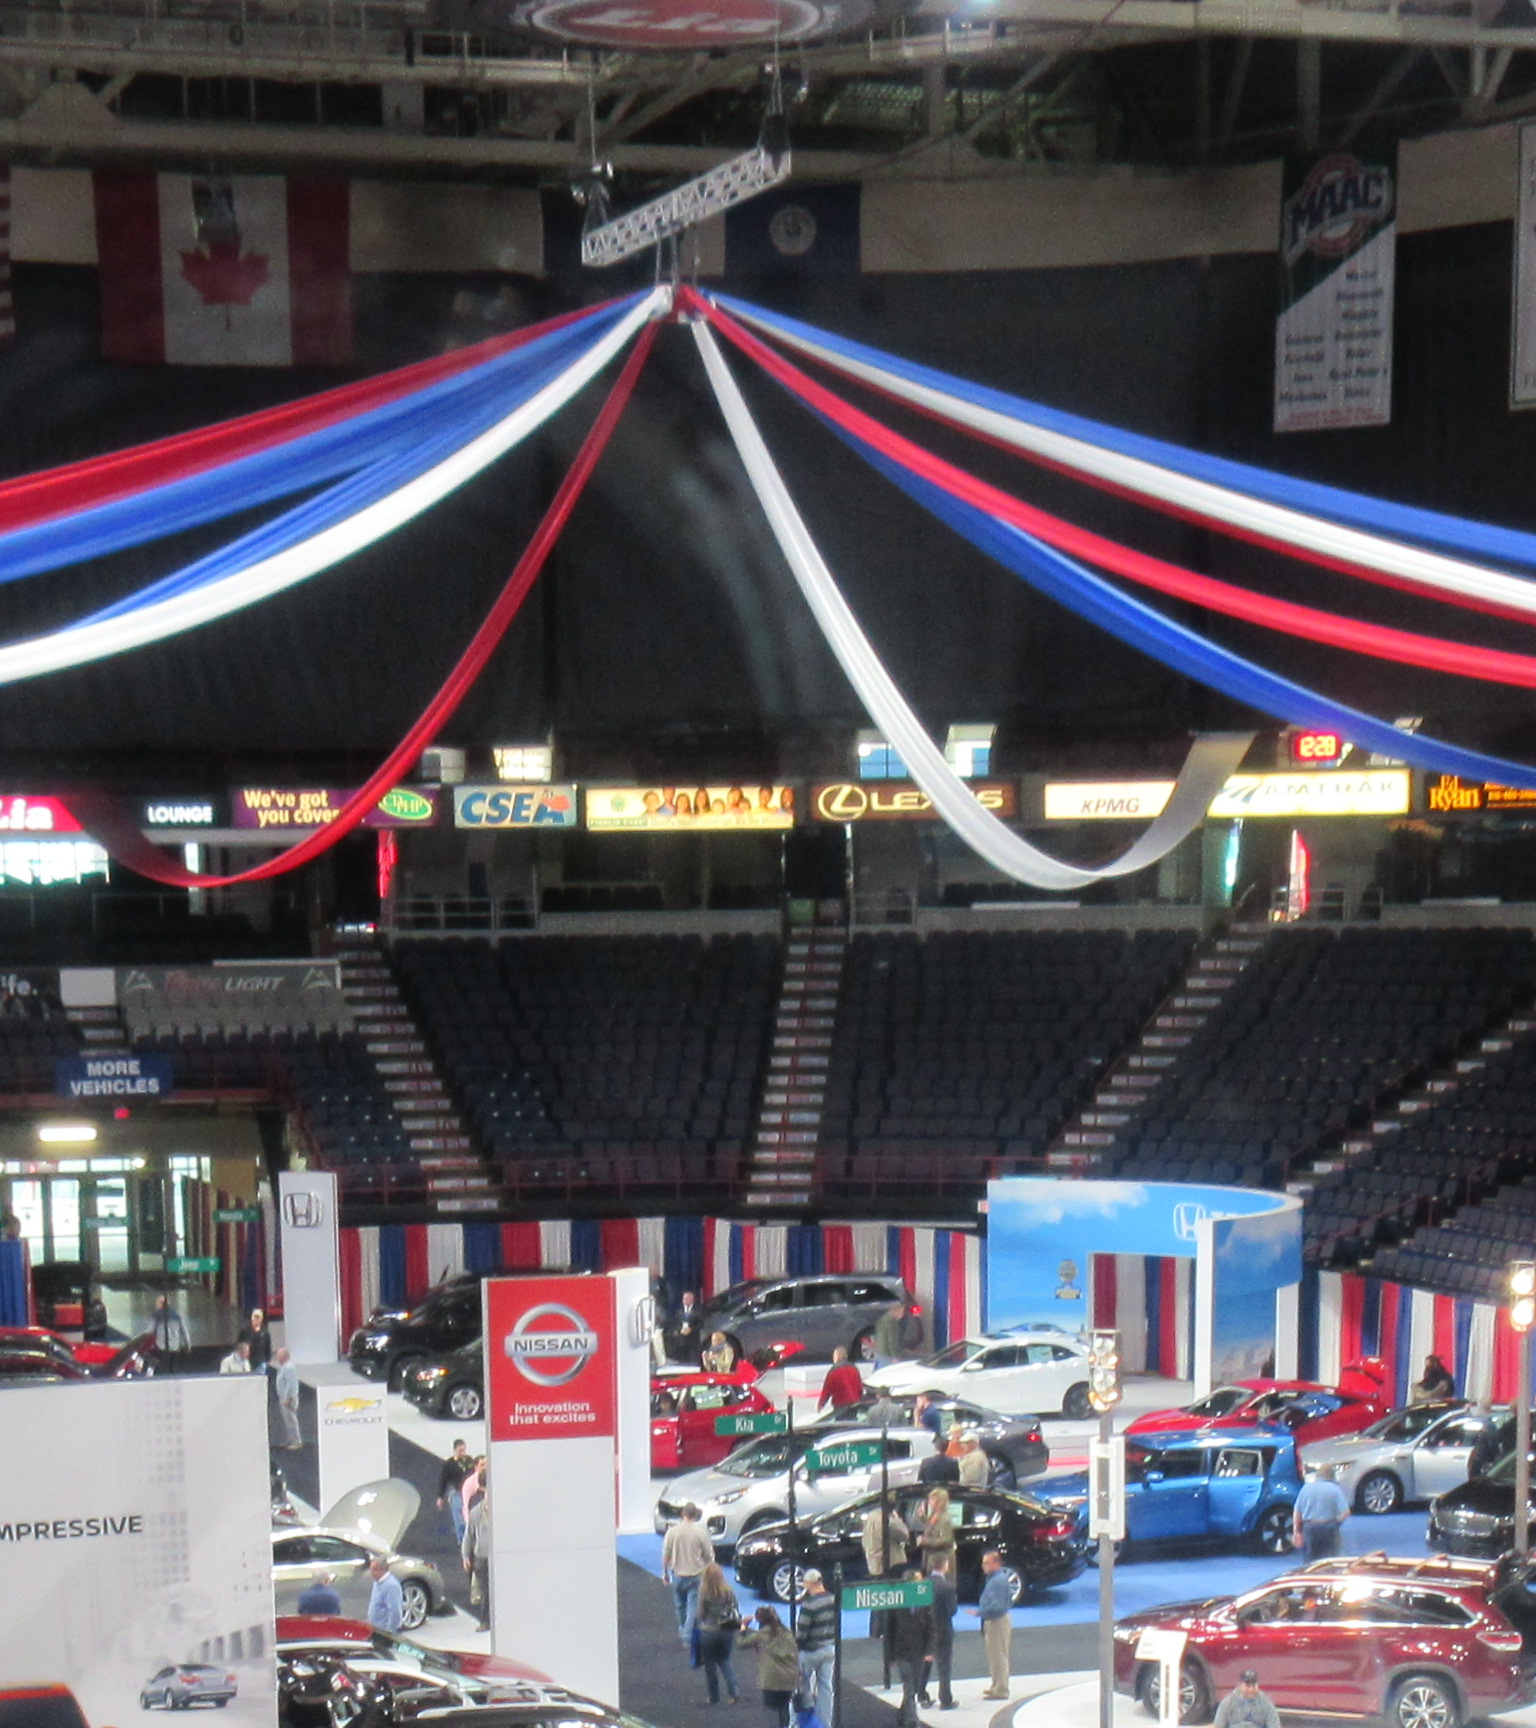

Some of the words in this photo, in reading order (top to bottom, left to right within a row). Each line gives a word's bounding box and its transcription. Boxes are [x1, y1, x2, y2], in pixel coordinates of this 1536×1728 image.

[1288, 173, 1384, 252] MAAC
[1264, 780, 1394, 795] AMTRAK
[244, 790, 292, 809] We've
[298, 791, 329, 812] got
[871, 790, 1004, 811] LES
[1080, 797, 1141, 814] KPMG
[1429, 787, 1480, 811] Ryan
[147, 806, 212, 824] LOUNGE
[258, 808, 290, 827] you
[462, 792, 566, 826] CSEA
[225, 976, 286, 991] LIGHT
[86, 1059, 141, 1077] MORE
[70, 1077, 161, 1096] VEHICLES
[514, 1337, 589, 1353] NISSAN
[515, 1402, 590, 1414] Innovation
[509, 1414, 542, 1425] that
[543, 1411, 596, 1424] excites
[735, 1418, 755, 1432] Kia
[817, 1450, 859, 1467] Toyota
[855, 1589, 905, 1608] Nissan
